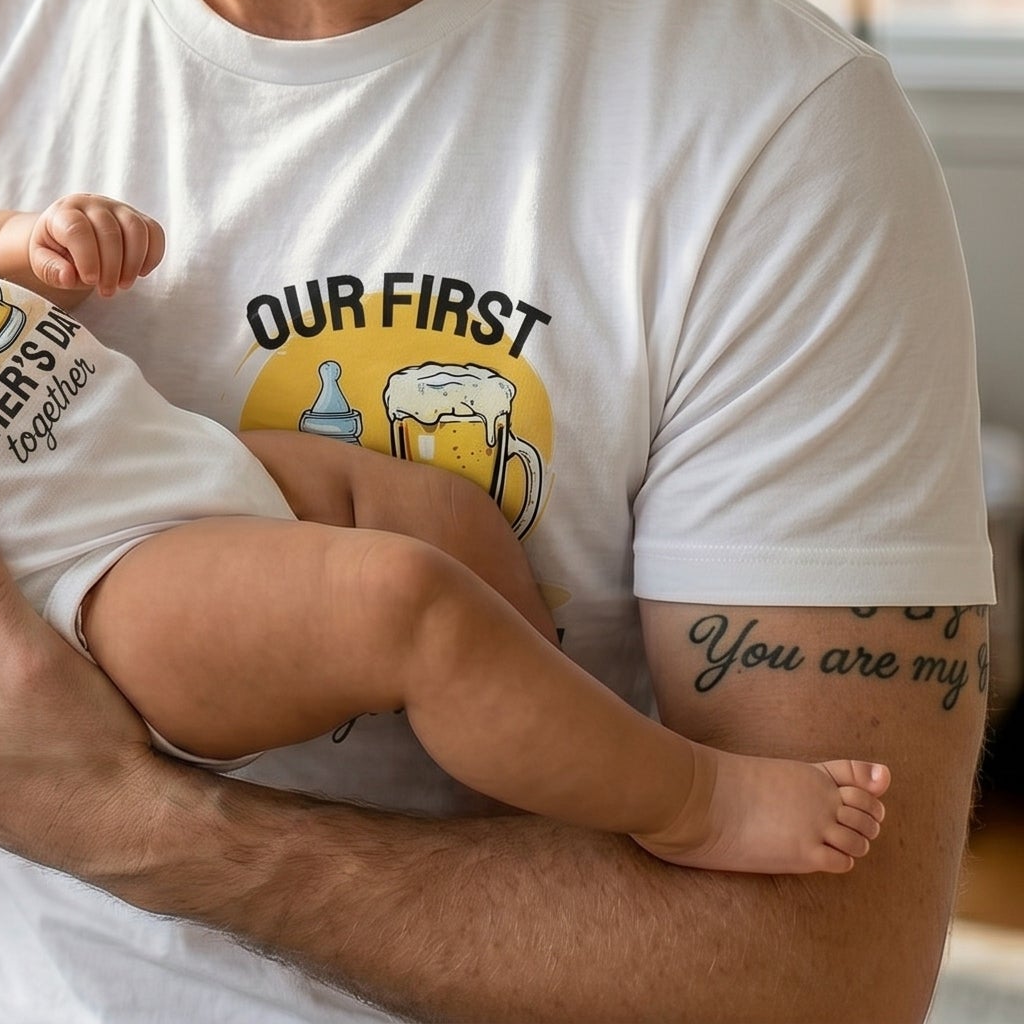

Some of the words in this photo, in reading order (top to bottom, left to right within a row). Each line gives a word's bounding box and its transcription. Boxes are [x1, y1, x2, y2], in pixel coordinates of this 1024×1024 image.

[246, 275, 366, 351] OUR
[381, 272, 552, 359] FIRST
[8, 356, 96, 464] together
[689, 614, 805, 693] You
[819, 646, 899, 679] are
[912, 654, 969, 711] my
